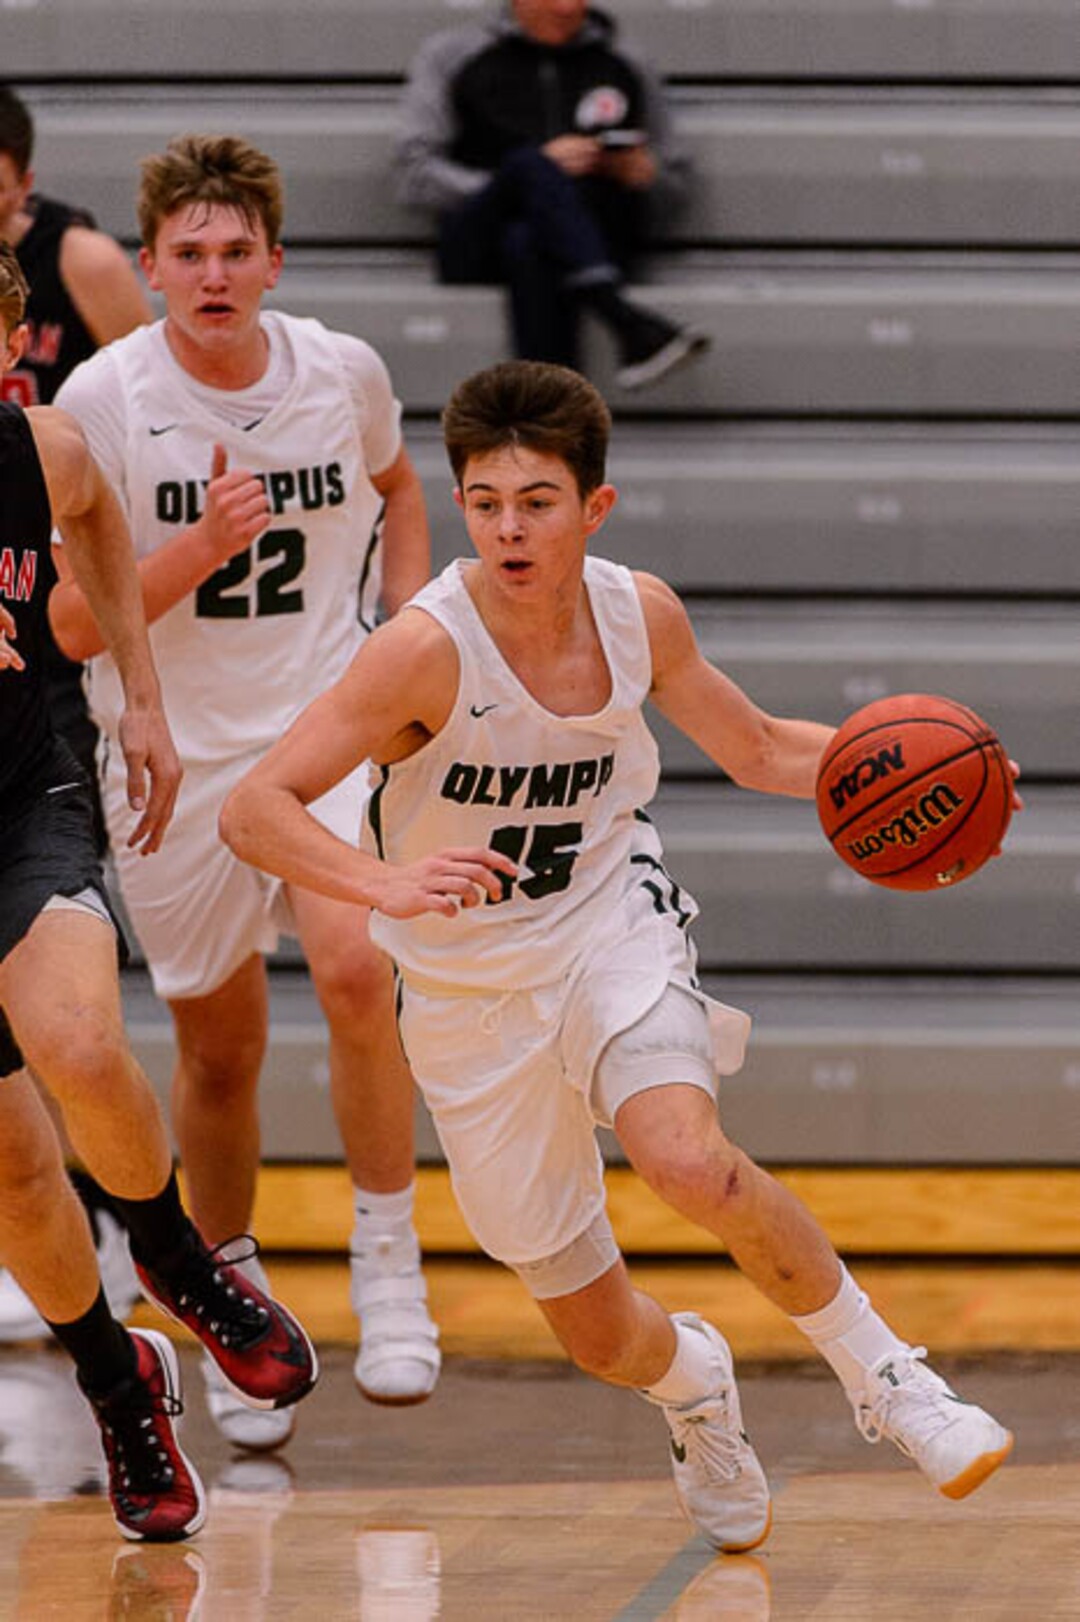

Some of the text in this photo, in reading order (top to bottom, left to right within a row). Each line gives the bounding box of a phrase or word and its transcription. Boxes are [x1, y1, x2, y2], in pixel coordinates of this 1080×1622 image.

[156, 461, 346, 525] OLPUS
[0, 547, 38, 602] AN
[195, 528, 306, 619] 22
[829, 743, 905, 810] NCAA
[847, 783, 964, 860] Wilson
[484, 822, 584, 905] 15
